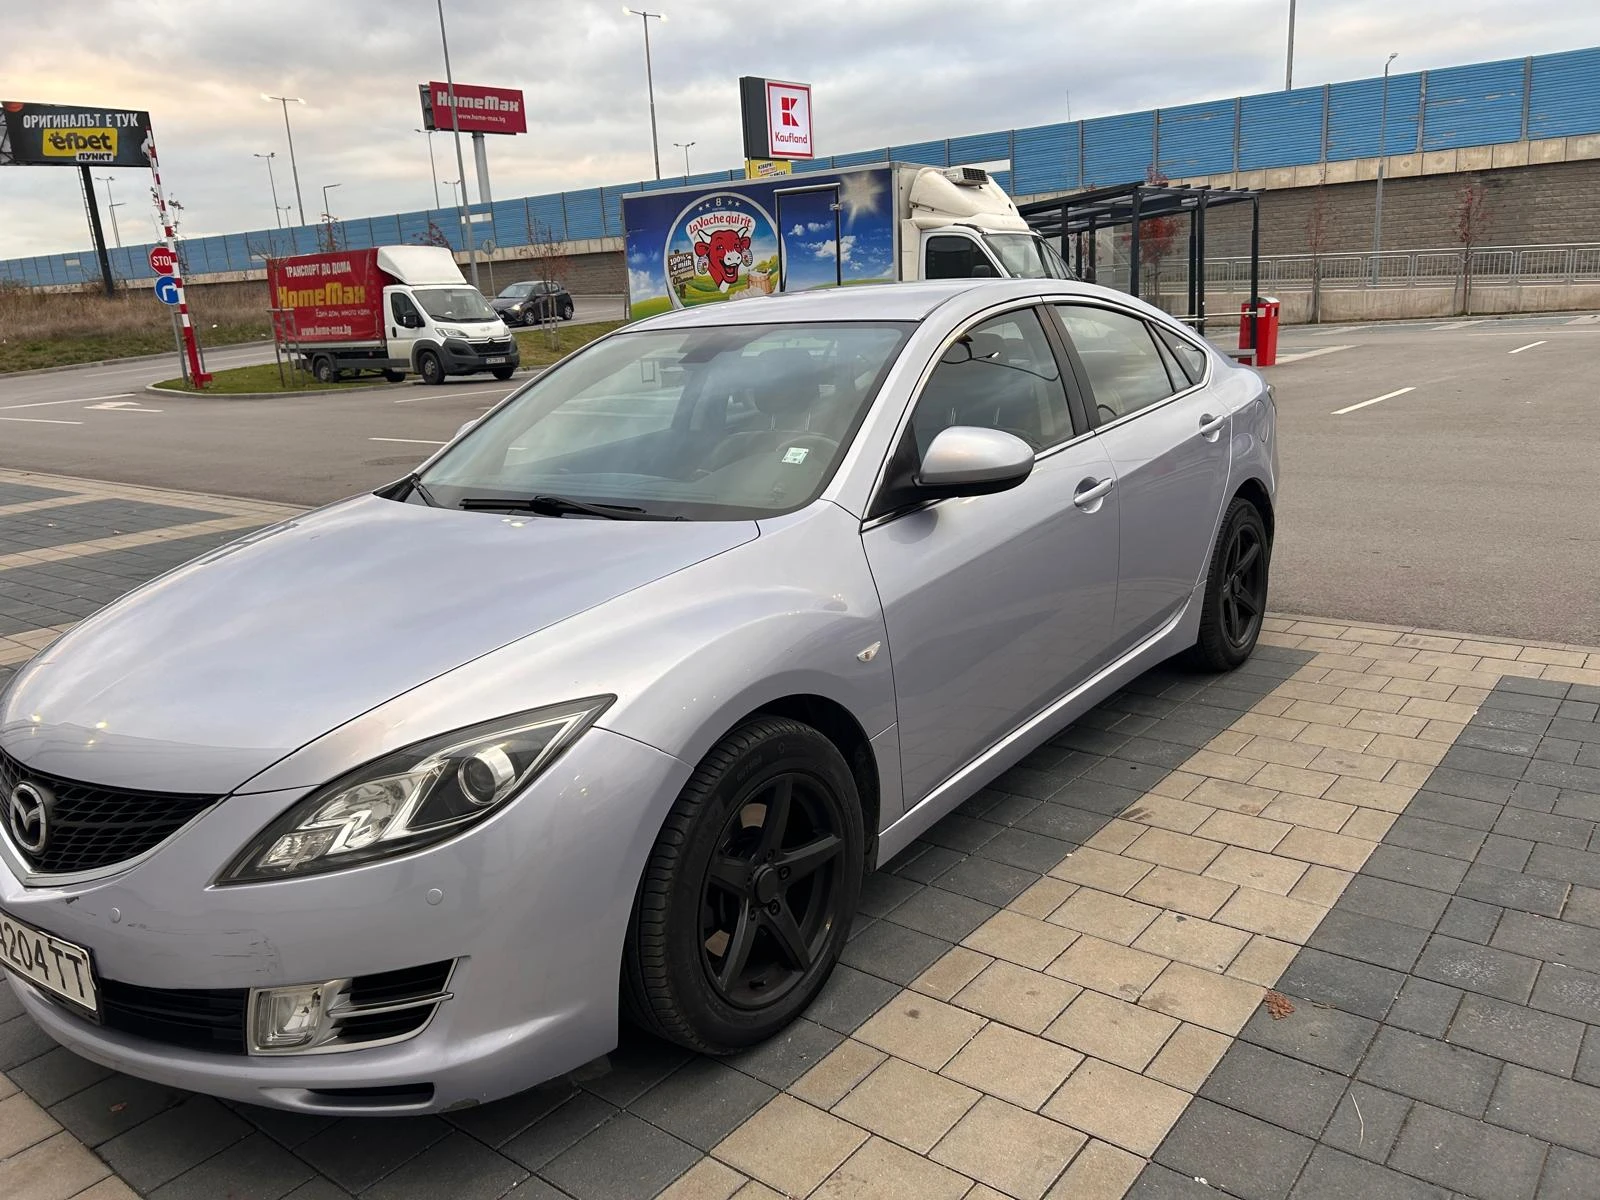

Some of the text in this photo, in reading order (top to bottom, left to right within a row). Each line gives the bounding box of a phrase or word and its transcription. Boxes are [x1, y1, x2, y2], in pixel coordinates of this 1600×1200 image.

[437, 91, 518, 112] HomeMax
[23, 113, 139, 128] ОРИГИНАЛЪТ Е ТУК
[49, 132, 112, 150] efbet
[775, 132, 808, 144] Kaufland
[78, 152, 112, 161] ПУНКТ
[696, 214, 725, 229] Vache
[725, 214, 740, 225] qui
[740, 217, 752, 227] rit
[285, 261, 351, 278] ТРАНСПОРТ ДО ДОМА
[278, 283, 365, 307] HomeMax
